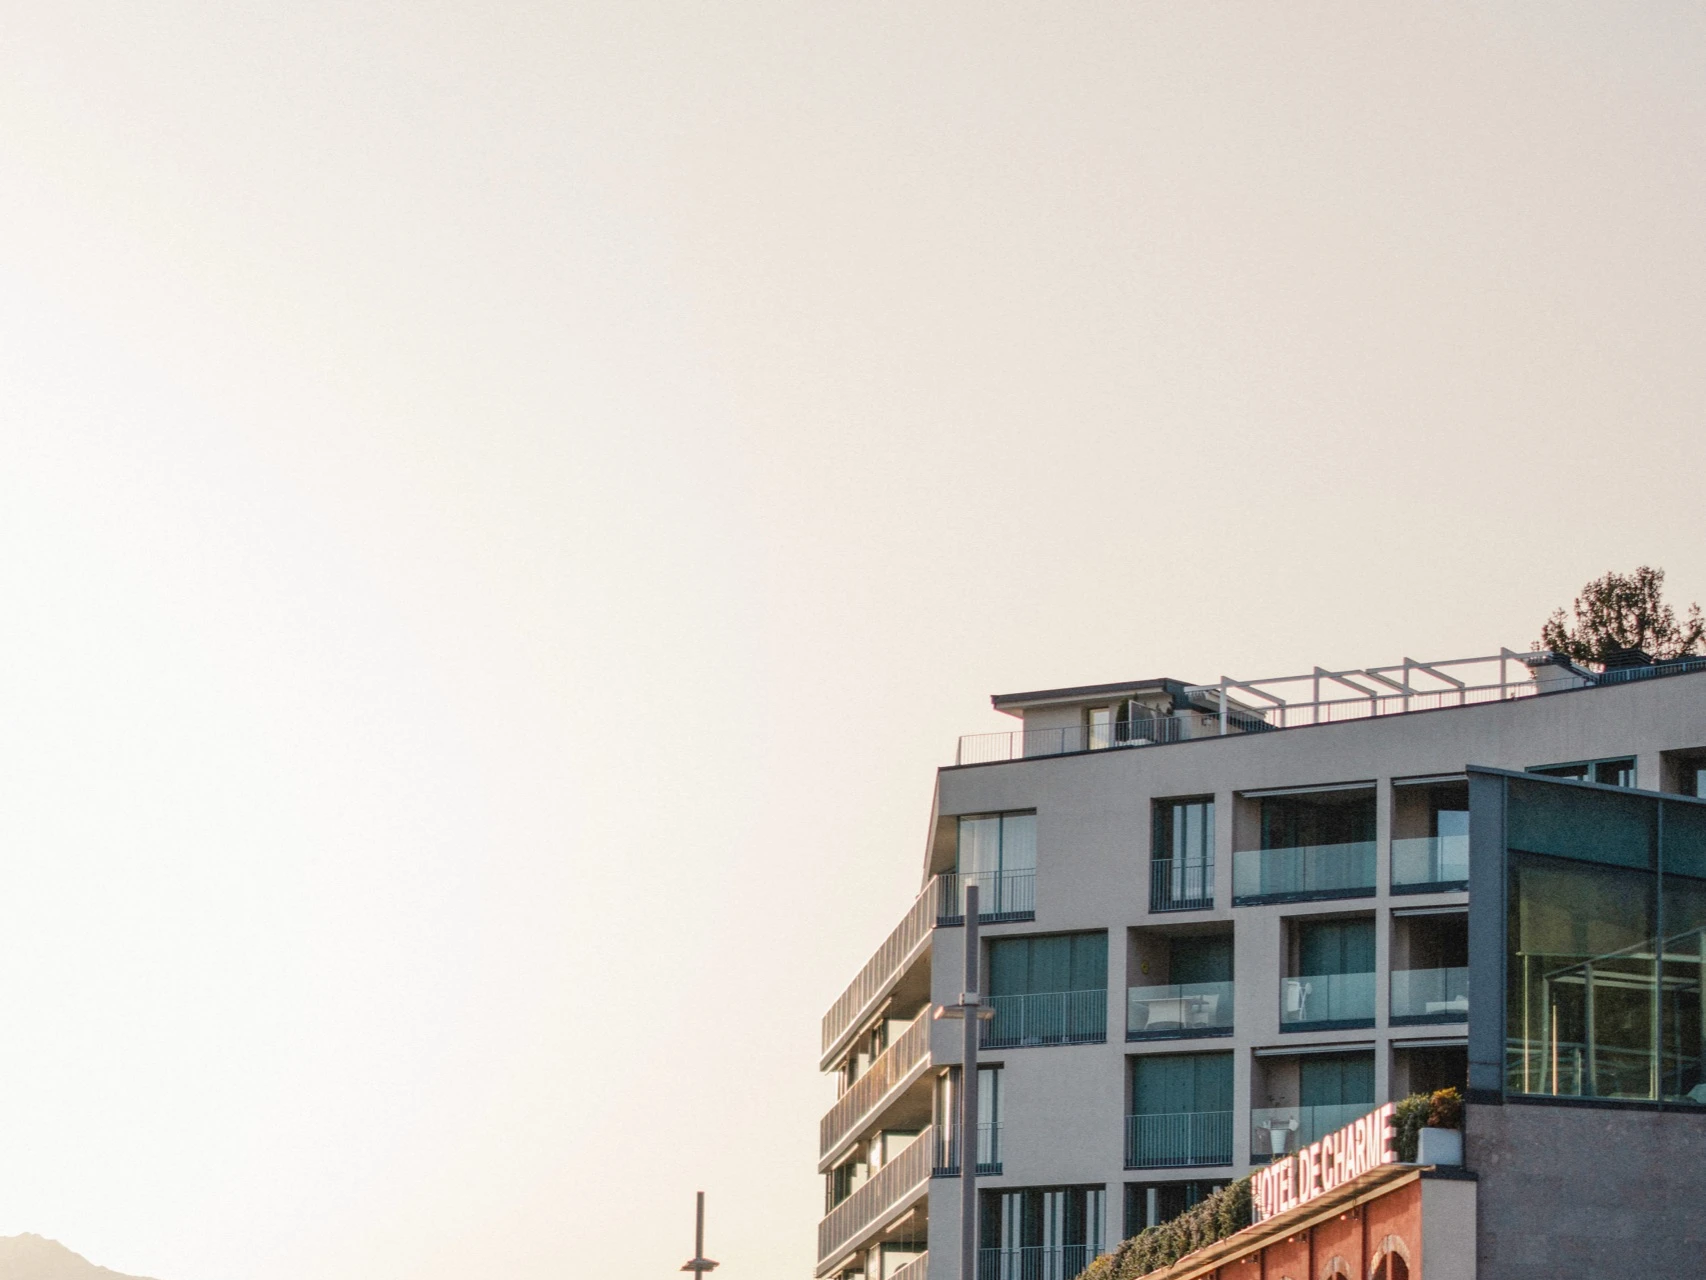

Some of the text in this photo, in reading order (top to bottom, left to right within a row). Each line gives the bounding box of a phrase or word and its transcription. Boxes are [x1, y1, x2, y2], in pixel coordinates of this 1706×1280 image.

[1251, 1102, 1397, 1222] HOTEL DE CHARME
